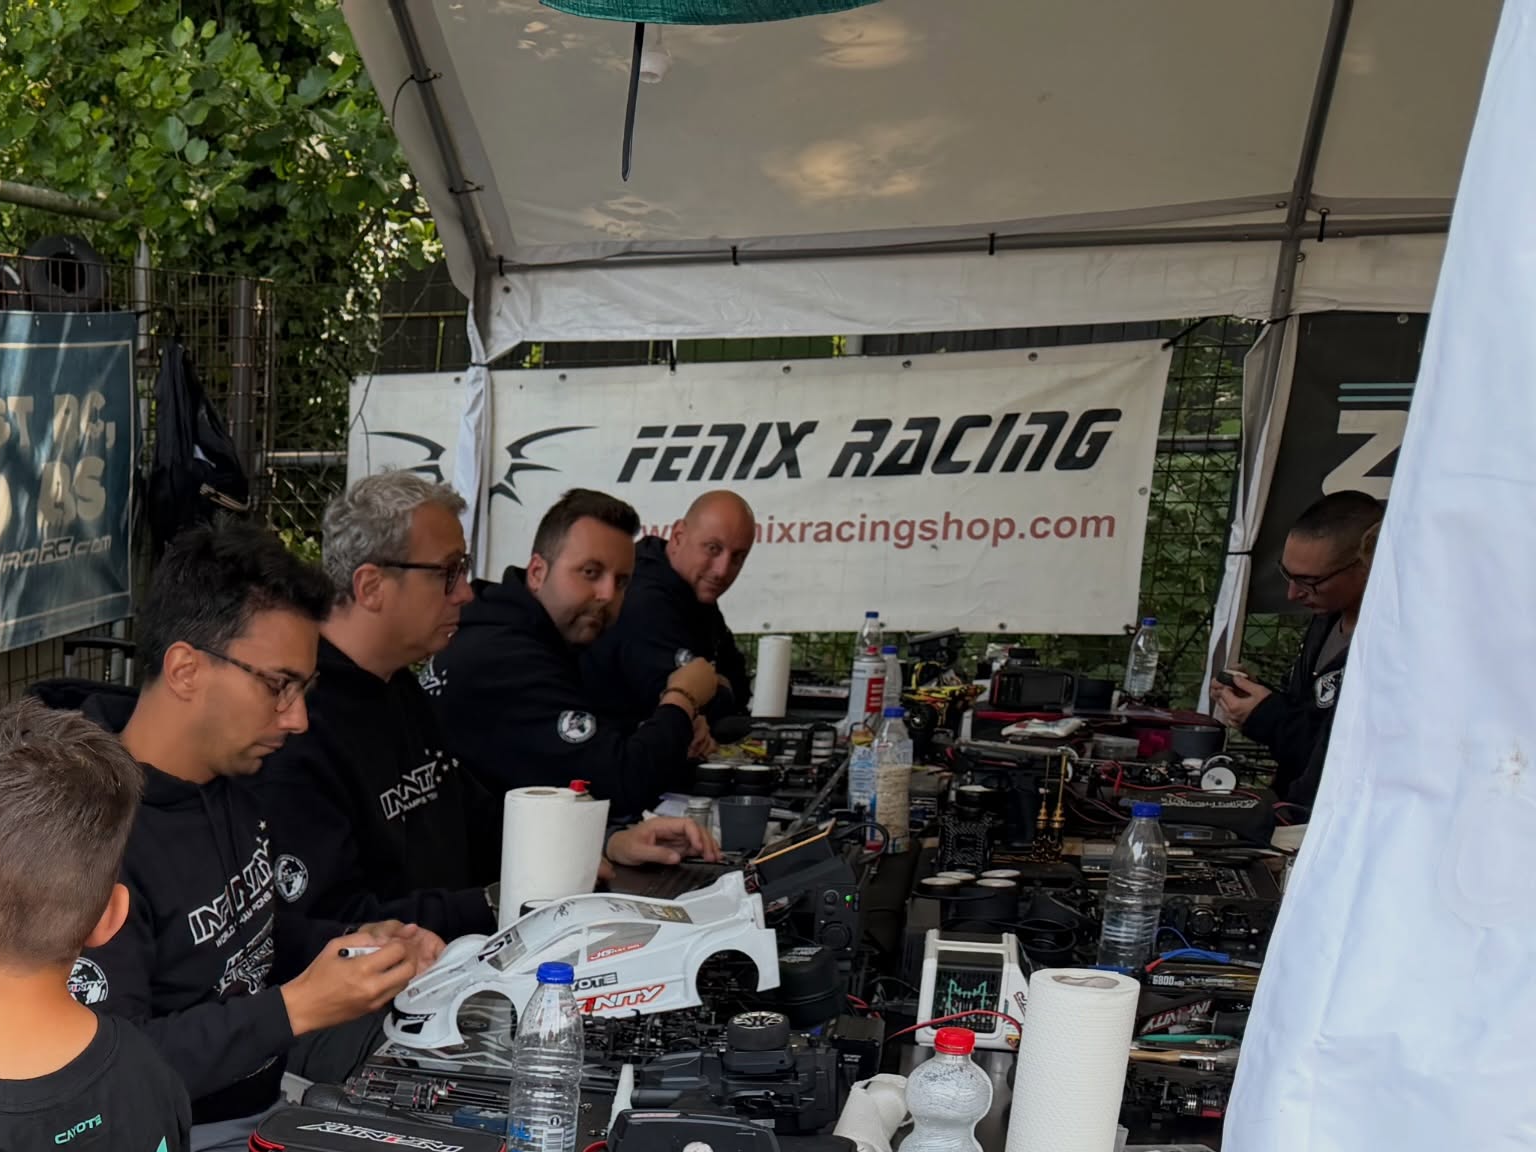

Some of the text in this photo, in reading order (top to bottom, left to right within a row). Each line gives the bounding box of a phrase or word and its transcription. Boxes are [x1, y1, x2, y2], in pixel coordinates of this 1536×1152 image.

[616, 408, 1122, 483] FENIX RACING
[570, 972, 618, 991] YOTE
[55, 1114, 102, 1144] CAYOTE
